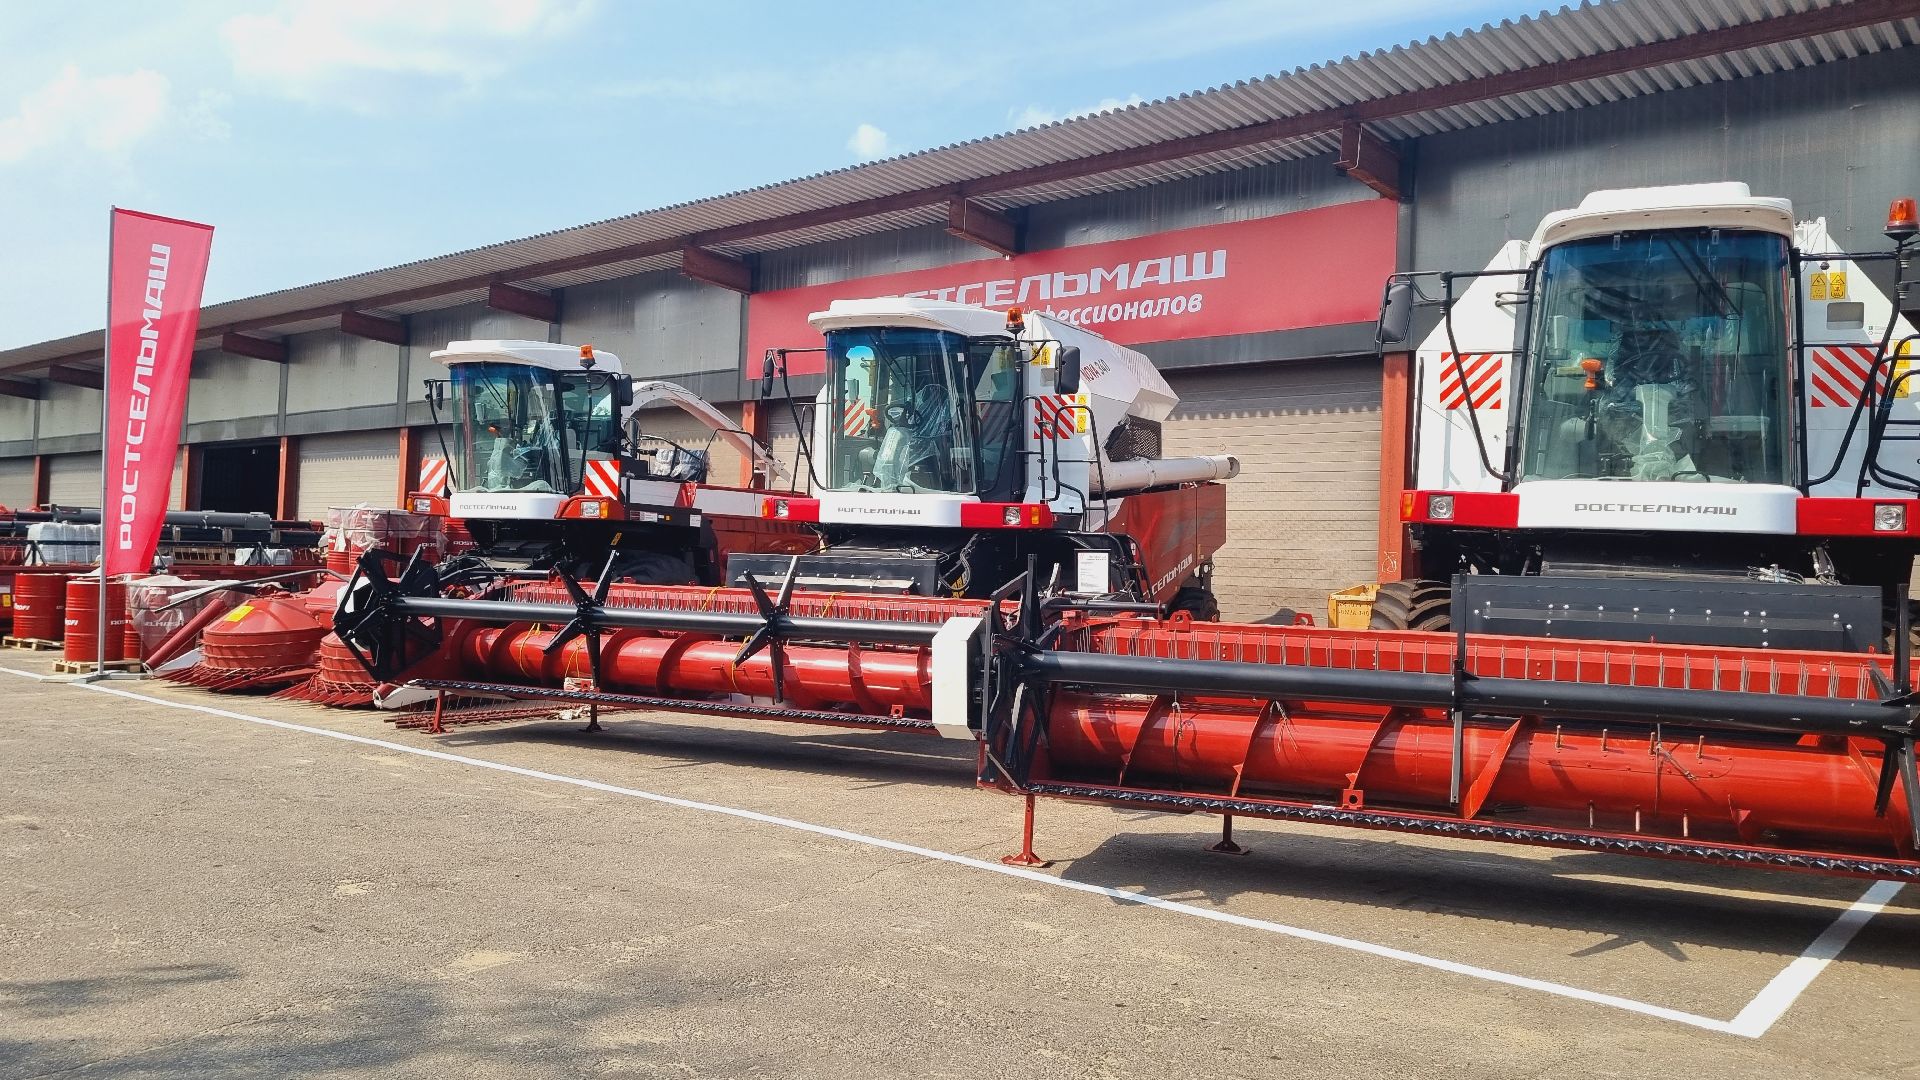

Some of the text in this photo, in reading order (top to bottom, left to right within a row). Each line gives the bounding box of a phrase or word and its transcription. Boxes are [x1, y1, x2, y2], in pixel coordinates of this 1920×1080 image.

[880, 249, 1227, 307] ТСЕЛЬМАШ
[1045, 293, 1203, 326] ессионалов
[119, 243, 171, 550] РОСТСЕЛЬМАШ
[1574, 503, 1738, 516] РОСТСЕЛЬМАШ
[1147, 553, 1193, 598] СЕЛЬМАШ
